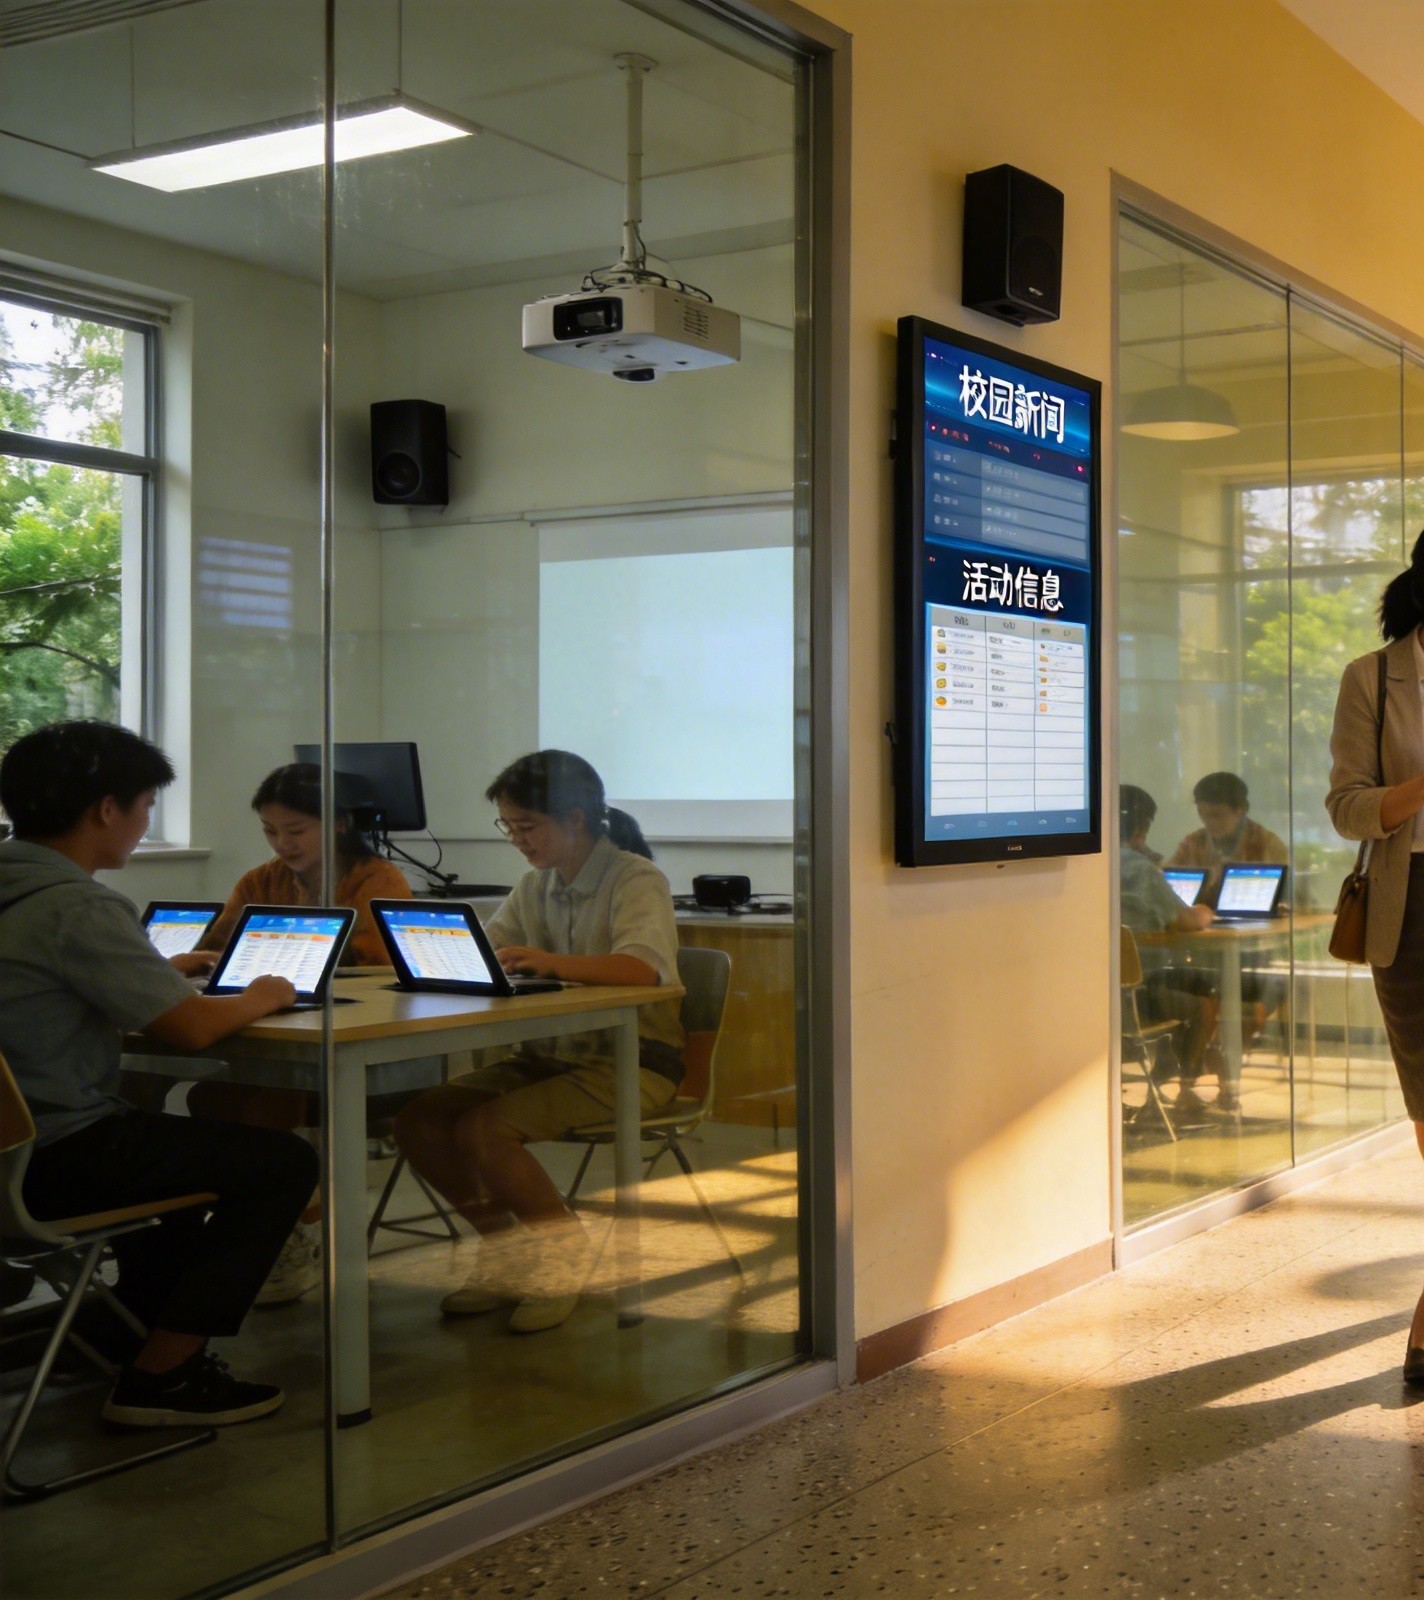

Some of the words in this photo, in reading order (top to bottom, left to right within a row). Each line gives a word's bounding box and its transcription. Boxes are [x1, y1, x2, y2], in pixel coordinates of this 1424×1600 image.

[959, 365, 1065, 443] 校园新闻
[962, 559, 1064, 611] 活动信息
